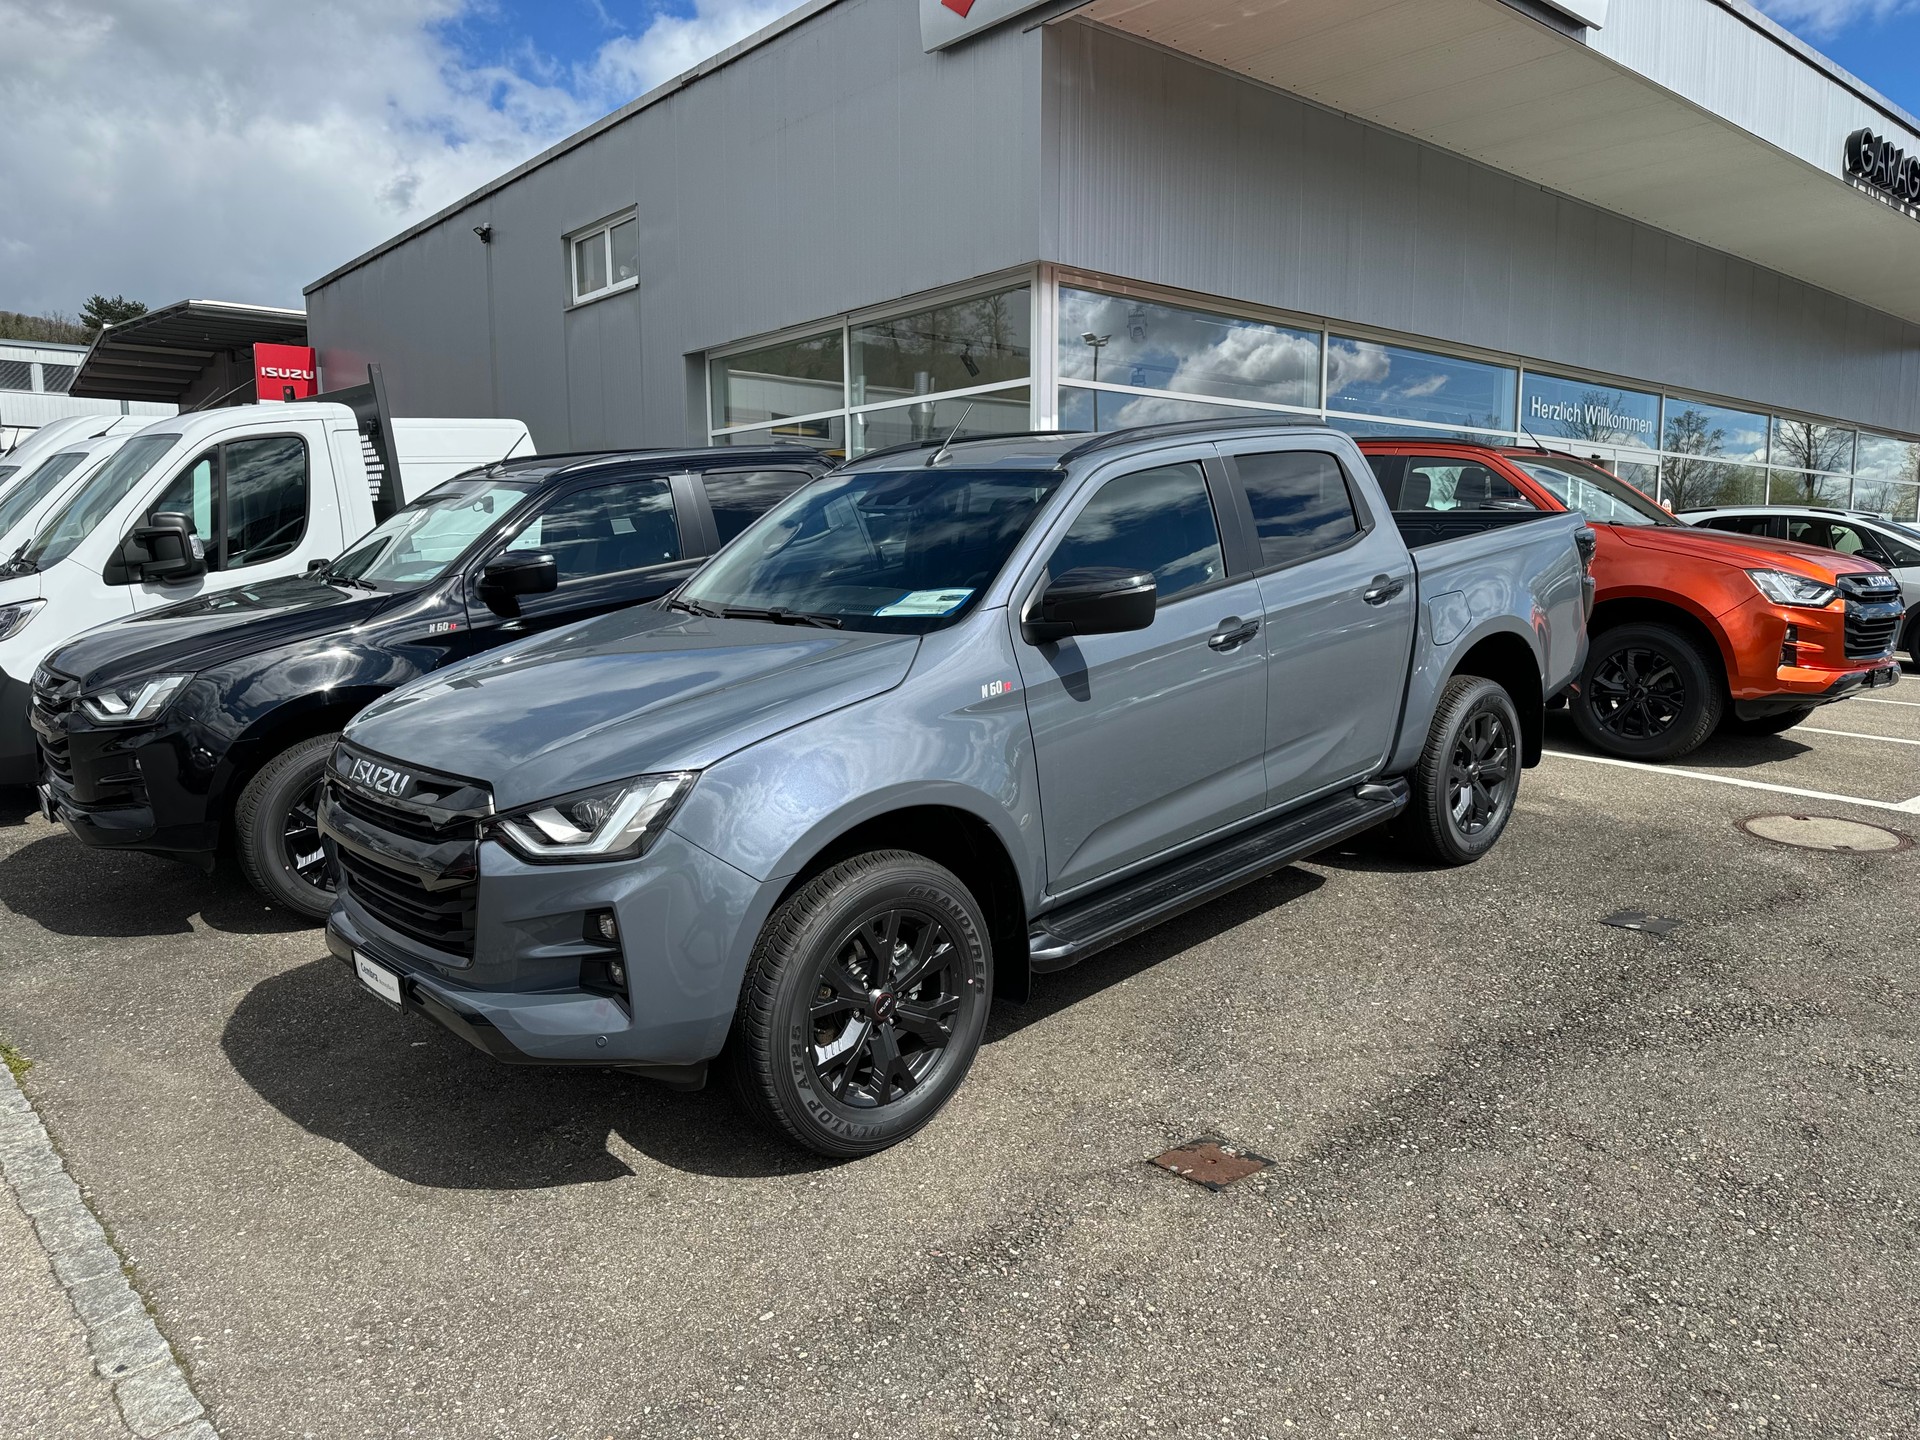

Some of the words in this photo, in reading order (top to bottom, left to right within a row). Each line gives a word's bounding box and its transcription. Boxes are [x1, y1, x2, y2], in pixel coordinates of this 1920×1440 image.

[261, 366, 314, 380] ISUZU
[1531, 395, 1581, 423] Herzlich
[1584, 403, 1653, 433] Willkommen
[349, 758, 410, 797] ISUZU
[908, 885, 986, 995] GRANDTREK
[791, 1025, 812, 1091] AT25
[806, 1100, 884, 1137] DUNLOP
